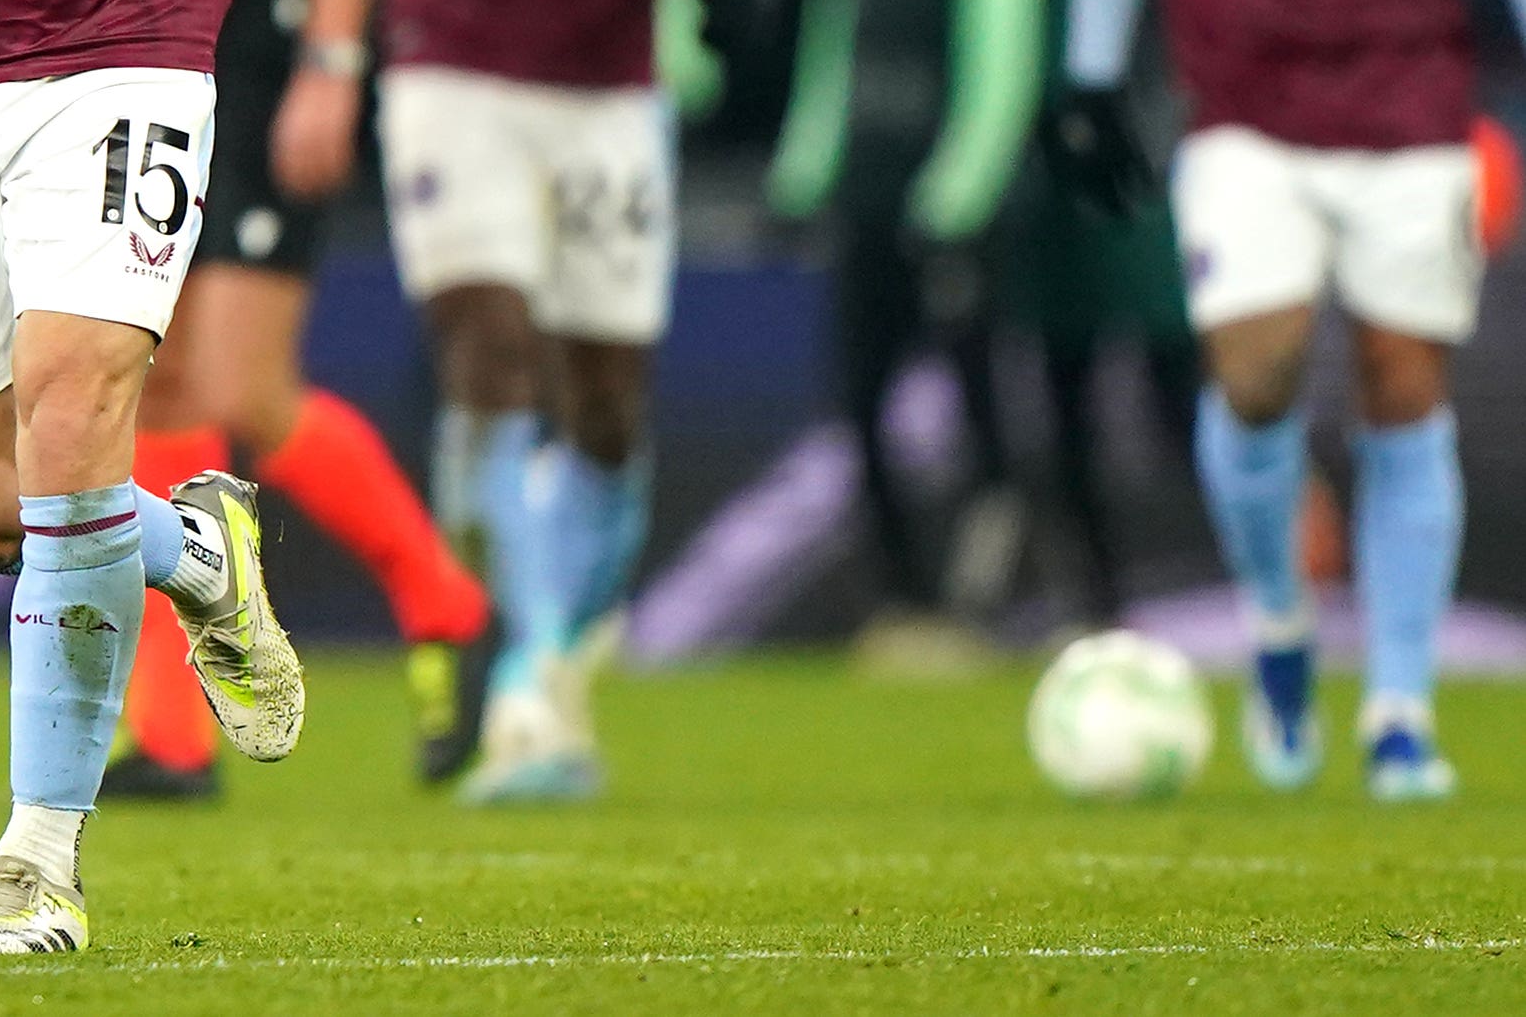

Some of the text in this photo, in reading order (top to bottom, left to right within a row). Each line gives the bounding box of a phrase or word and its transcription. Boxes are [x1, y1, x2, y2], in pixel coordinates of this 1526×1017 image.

[92, 118, 190, 236] 15
[124, 265, 170, 283] CASTORE
[15, 613, 119, 633] VILLA
